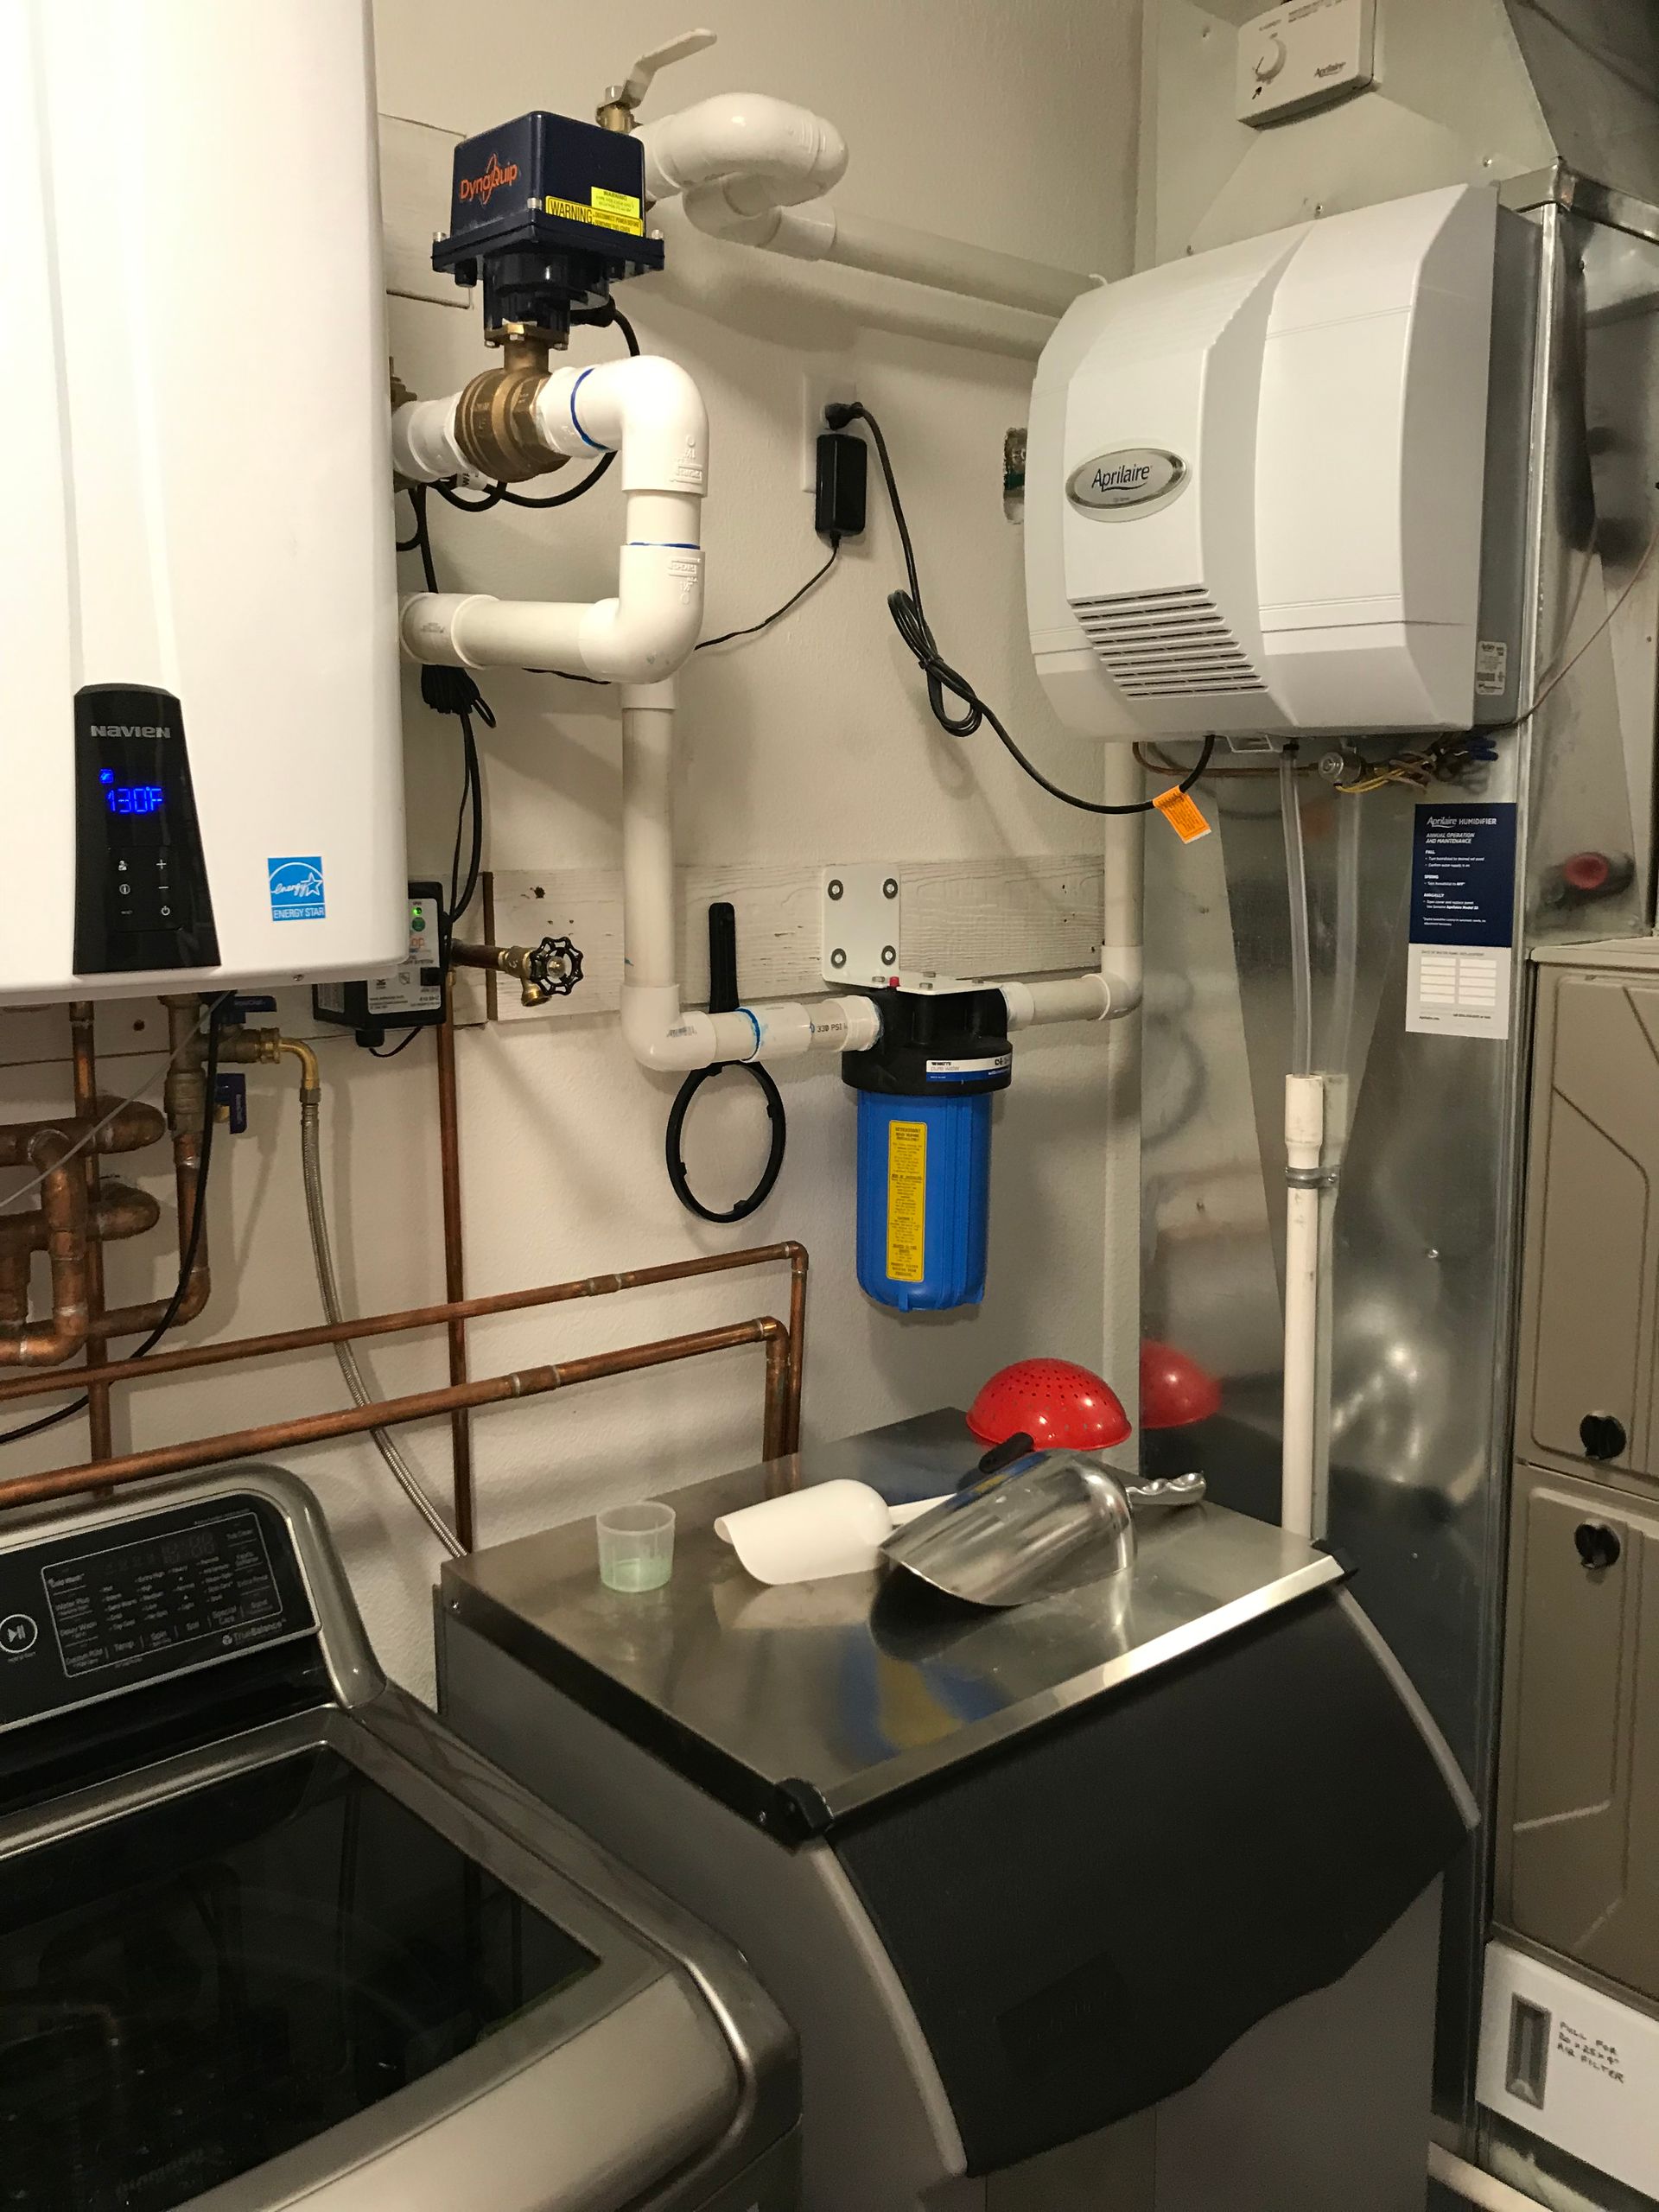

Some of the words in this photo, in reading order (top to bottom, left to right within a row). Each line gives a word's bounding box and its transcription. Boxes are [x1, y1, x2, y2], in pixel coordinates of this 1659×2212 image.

[1091, 463, 1151, 492] Aprilaire
[1426, 817, 1458, 828] Aprilaire
[273, 908, 304, 918] ENERGY
[304, 906, 324, 917] STAR
